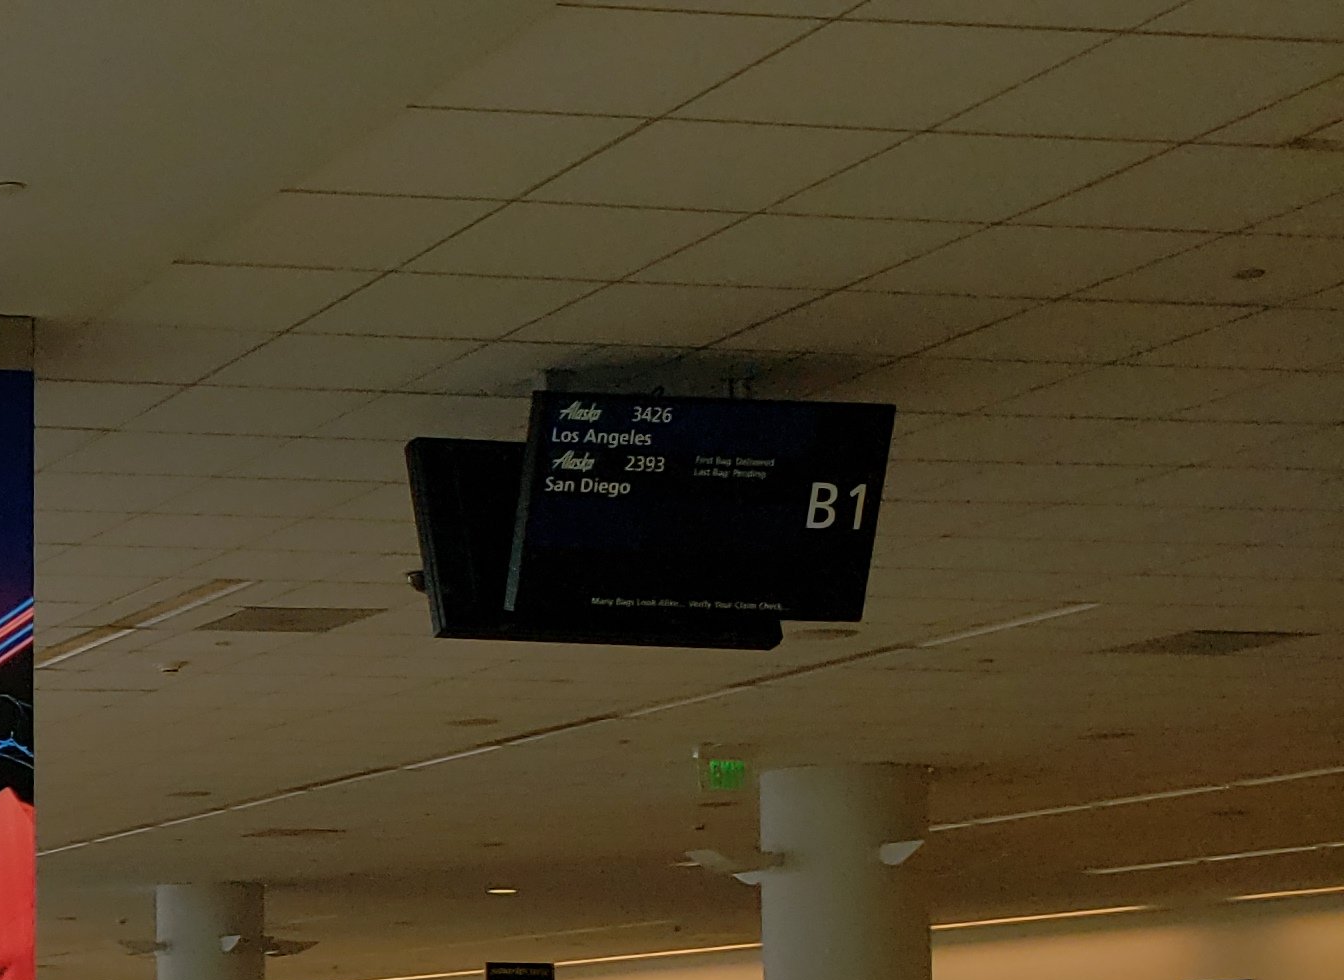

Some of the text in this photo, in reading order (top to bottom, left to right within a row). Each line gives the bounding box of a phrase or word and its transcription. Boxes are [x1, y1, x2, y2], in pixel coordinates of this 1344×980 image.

[559, 400, 673, 423] Alaska 3426
[551, 427, 652, 448] Los Angeles
[552, 450, 665, 472] Alaska 2393
[545, 476, 631, 497] San Diego
[806, 482, 867, 530] B1
